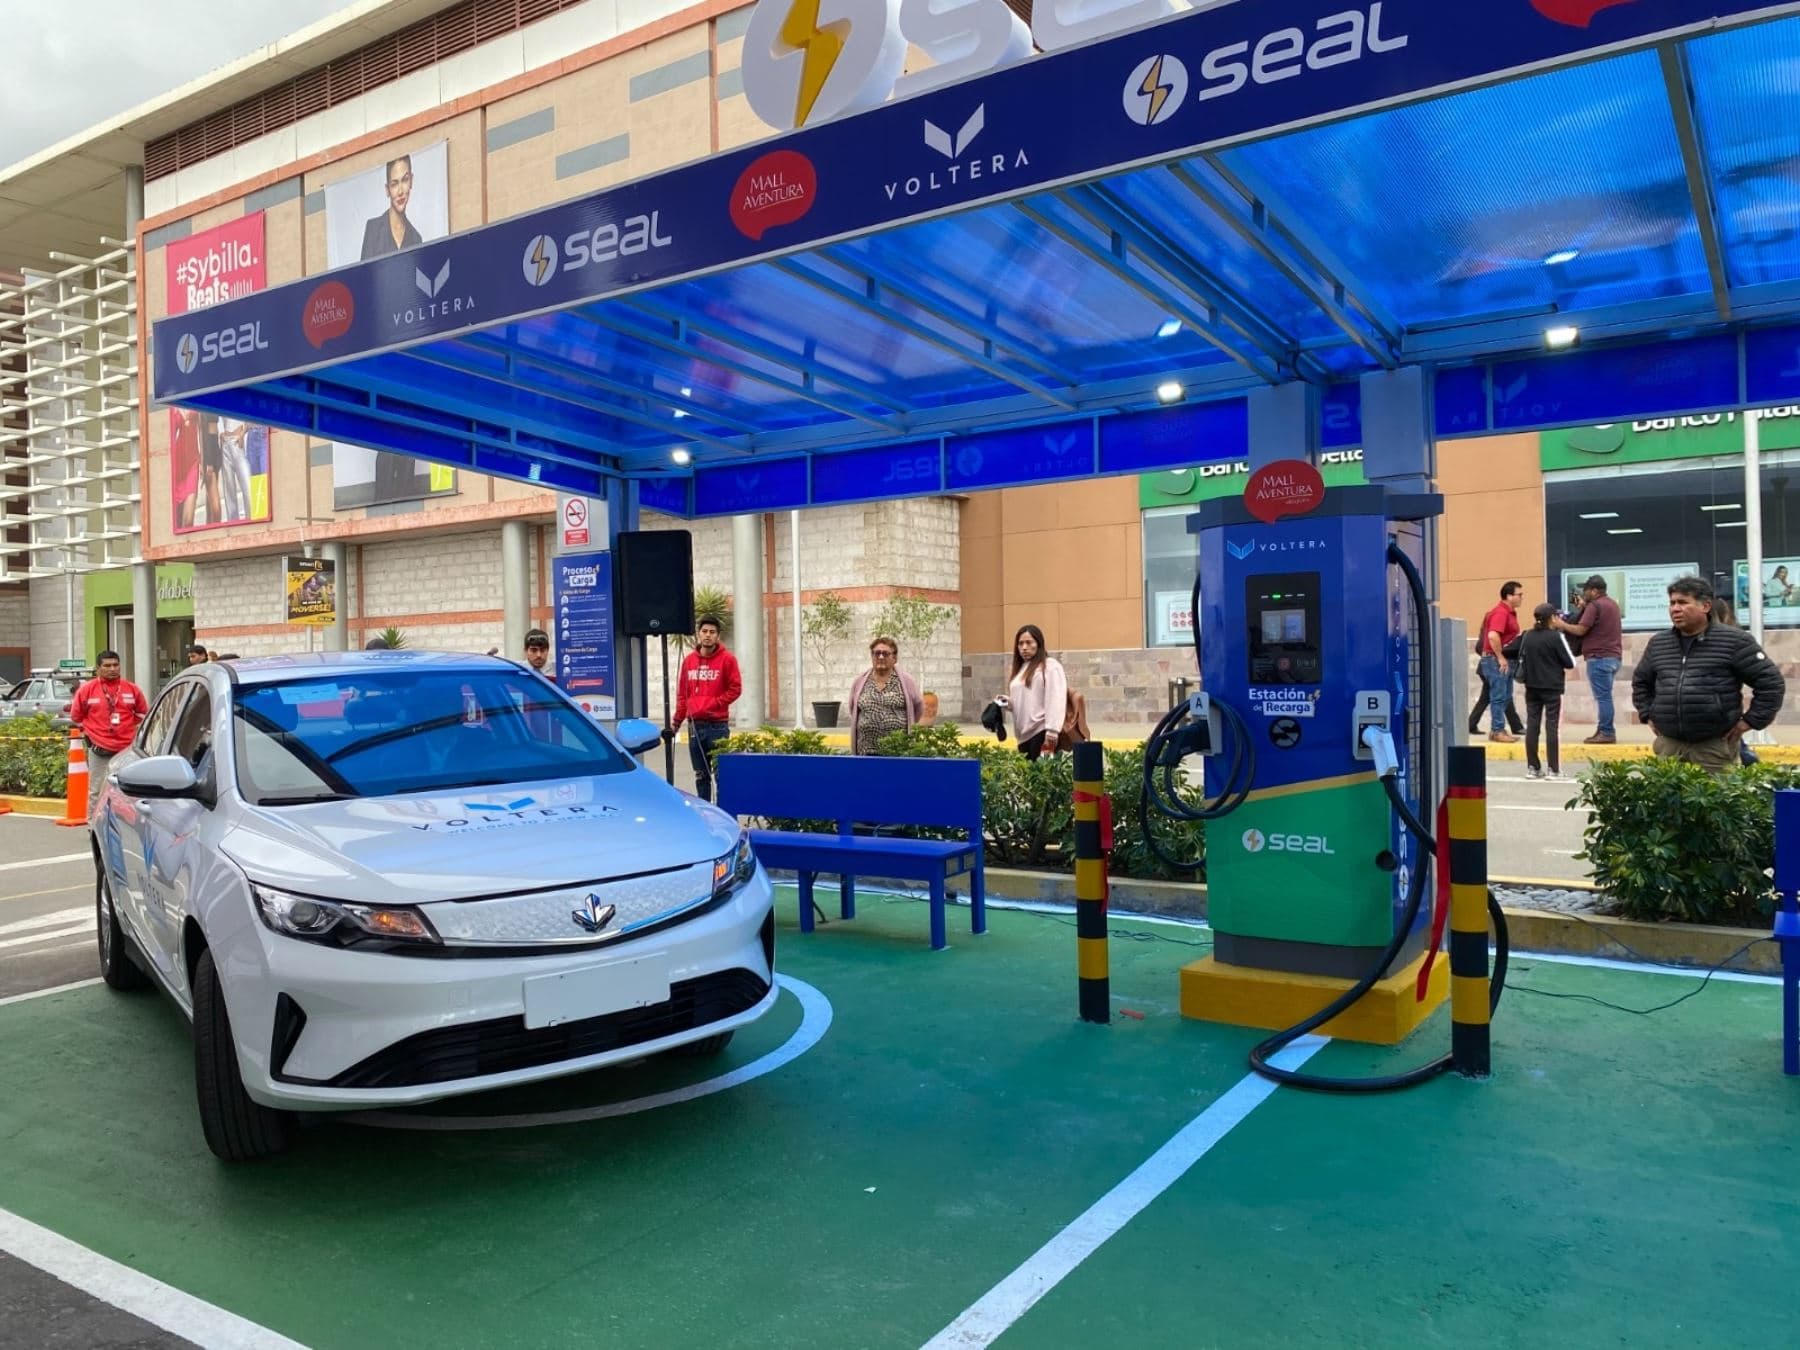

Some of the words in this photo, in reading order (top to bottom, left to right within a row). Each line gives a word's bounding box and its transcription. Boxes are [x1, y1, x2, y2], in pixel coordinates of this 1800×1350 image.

[1199, 2, 1408, 101] seal
[750, 172, 785, 193] MALL
[885, 149, 1028, 200] VOLTERA
[743, 183, 804, 210] AVENTURA
[564, 210, 672, 272] seal
[176, 240, 258, 284] #Sybilla.
[187, 277, 229, 310] Beats
[394, 296, 475, 326] VOLTERA
[202, 321, 268, 363] seal
[1262, 474, 1295, 488] MALL
[1256, 484, 1312, 501] AVENTURA
[1260, 540, 1325, 551] VOLTERA
[572, 576, 594, 585] Carga
[1194, 700, 1204, 709] A
[1248, 688, 1306, 701] Estación
[1367, 696, 1379, 710] B
[1252, 704, 1263, 712] de
[1265, 702, 1311, 713] Recarga
[411, 803, 619, 832] VOLTERA
[1268, 833, 1335, 854] seal
